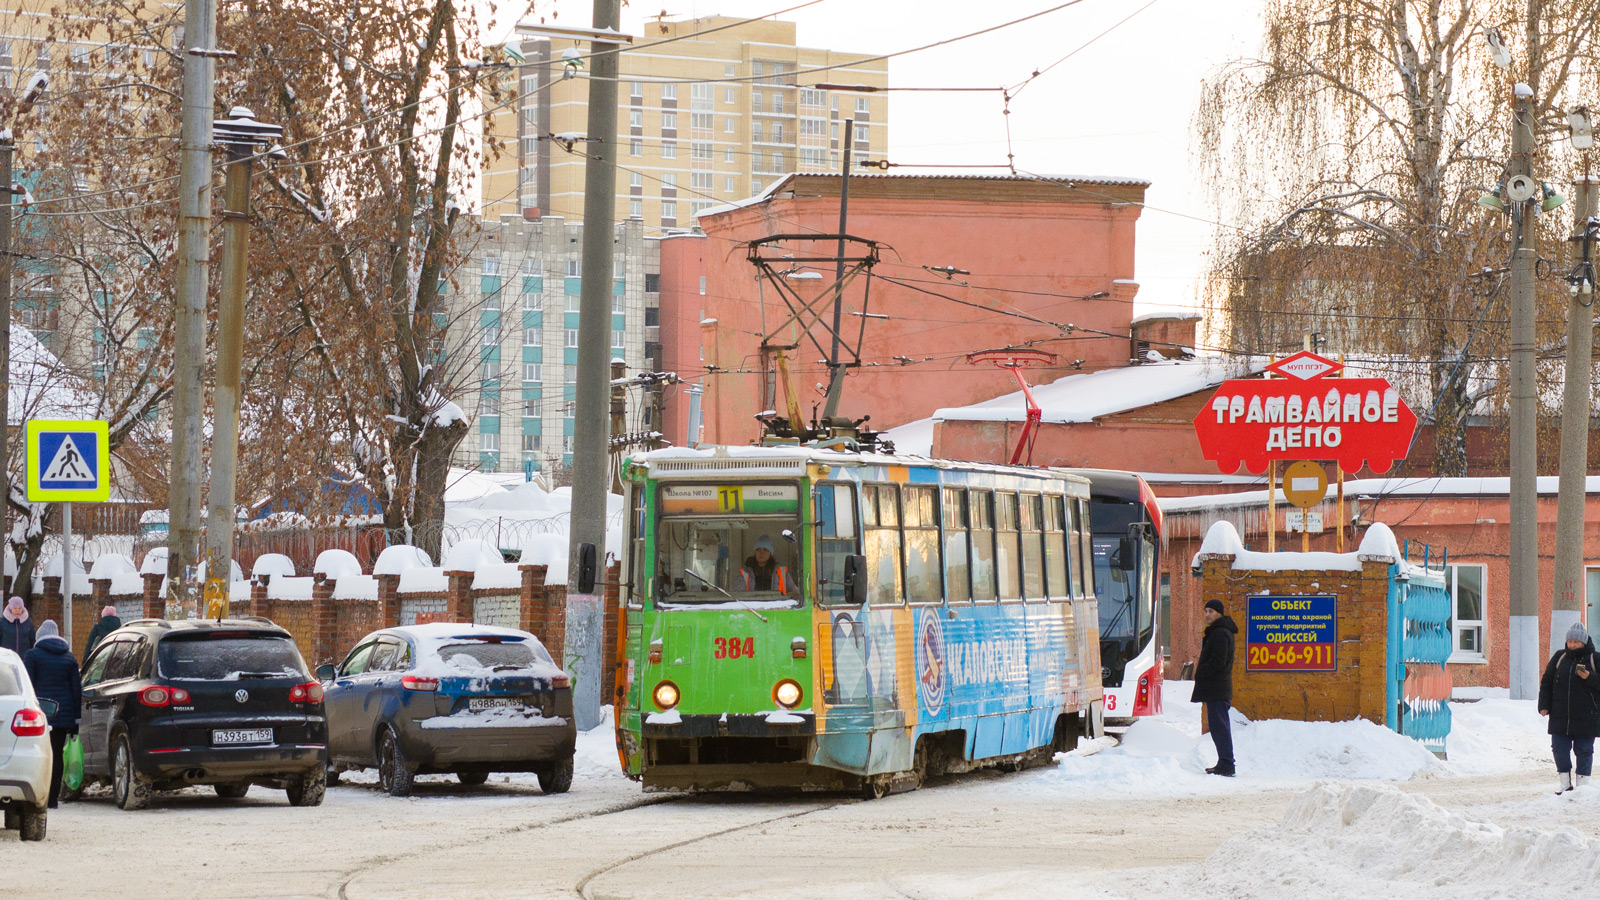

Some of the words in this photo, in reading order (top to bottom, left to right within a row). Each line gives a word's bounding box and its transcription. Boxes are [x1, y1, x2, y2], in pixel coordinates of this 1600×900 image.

[1212, 396, 1399, 424] ТРАМВАЙНОЕ
[1266, 427, 1342, 451] ДЕПО
[719, 490, 740, 512] 11
[1271, 600, 1312, 610] ОБЪЕКТ
[714, 636, 755, 660] 384
[1266, 631, 1317, 643] ОДИССЕЙ
[1250, 646, 1332, 665] 20-66-911
